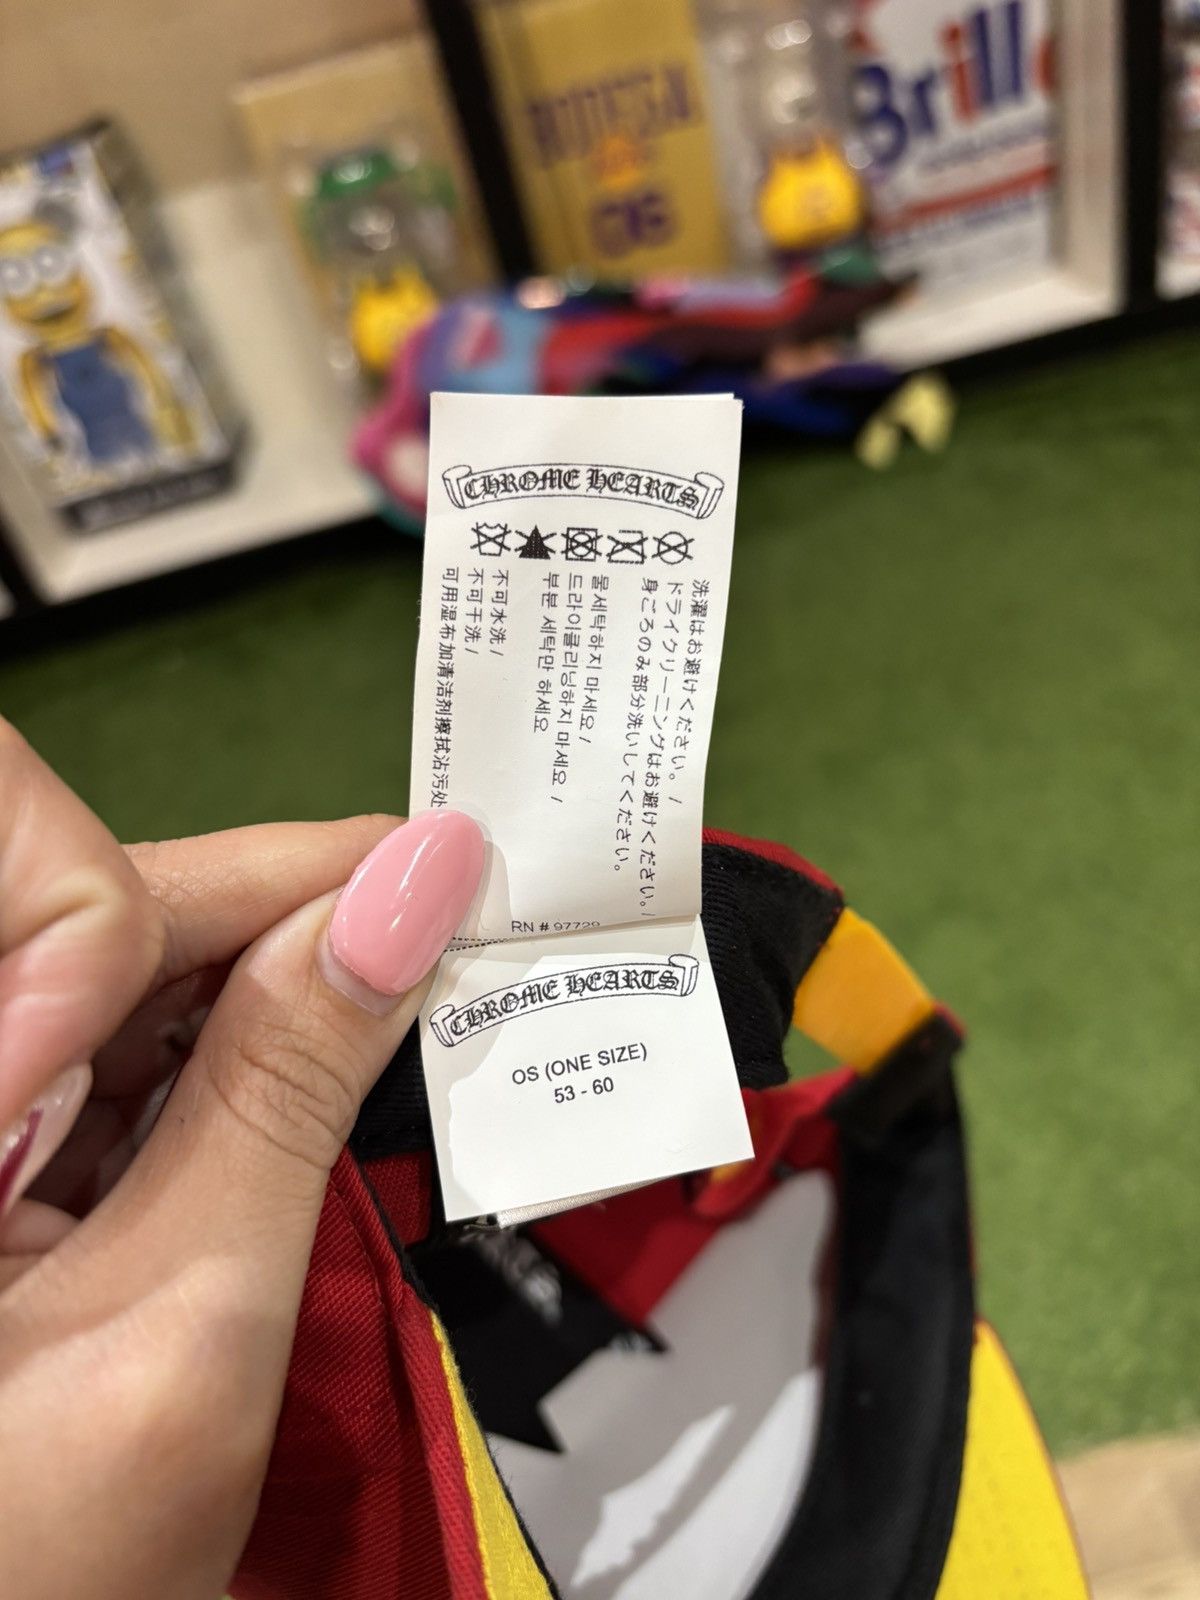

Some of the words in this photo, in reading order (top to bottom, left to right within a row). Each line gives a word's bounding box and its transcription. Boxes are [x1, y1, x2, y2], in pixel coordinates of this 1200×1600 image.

[464, 468, 580, 501] CHROME
[586, 468, 699, 511] HEARTS
[464, 567, 485, 643] 不可干洗
[489, 569, 509, 645] 不可水洗
[542, 570, 560, 609] 부분
[537, 615, 557, 672] 세탁만
[557, 572, 584, 725] 드라이클리닝하지
[585, 573, 610, 669] 물세탁하지
[533, 679, 553, 734] 하세요
[579, 676, 600, 731] 마세요
[669, 579, 710, 781] 洗濯はお避けください。
[614, 577, 660, 871] 身ごろのみ部分洗いしてください。
[552, 731, 571, 786] 마세요
[511, 920, 534, 933] RN
[539, 921, 550, 932] #
[450, 979, 560, 1036] CHROME
[564, 969, 679, 997] HEARTS
[512, 1065, 539, 1085] OS
[545, 1053, 593, 1082] (ONE
[598, 1042, 648, 1066] SIZE)
[554, 1085, 576, 1104] 53
[592, 1076, 615, 1096] 60
